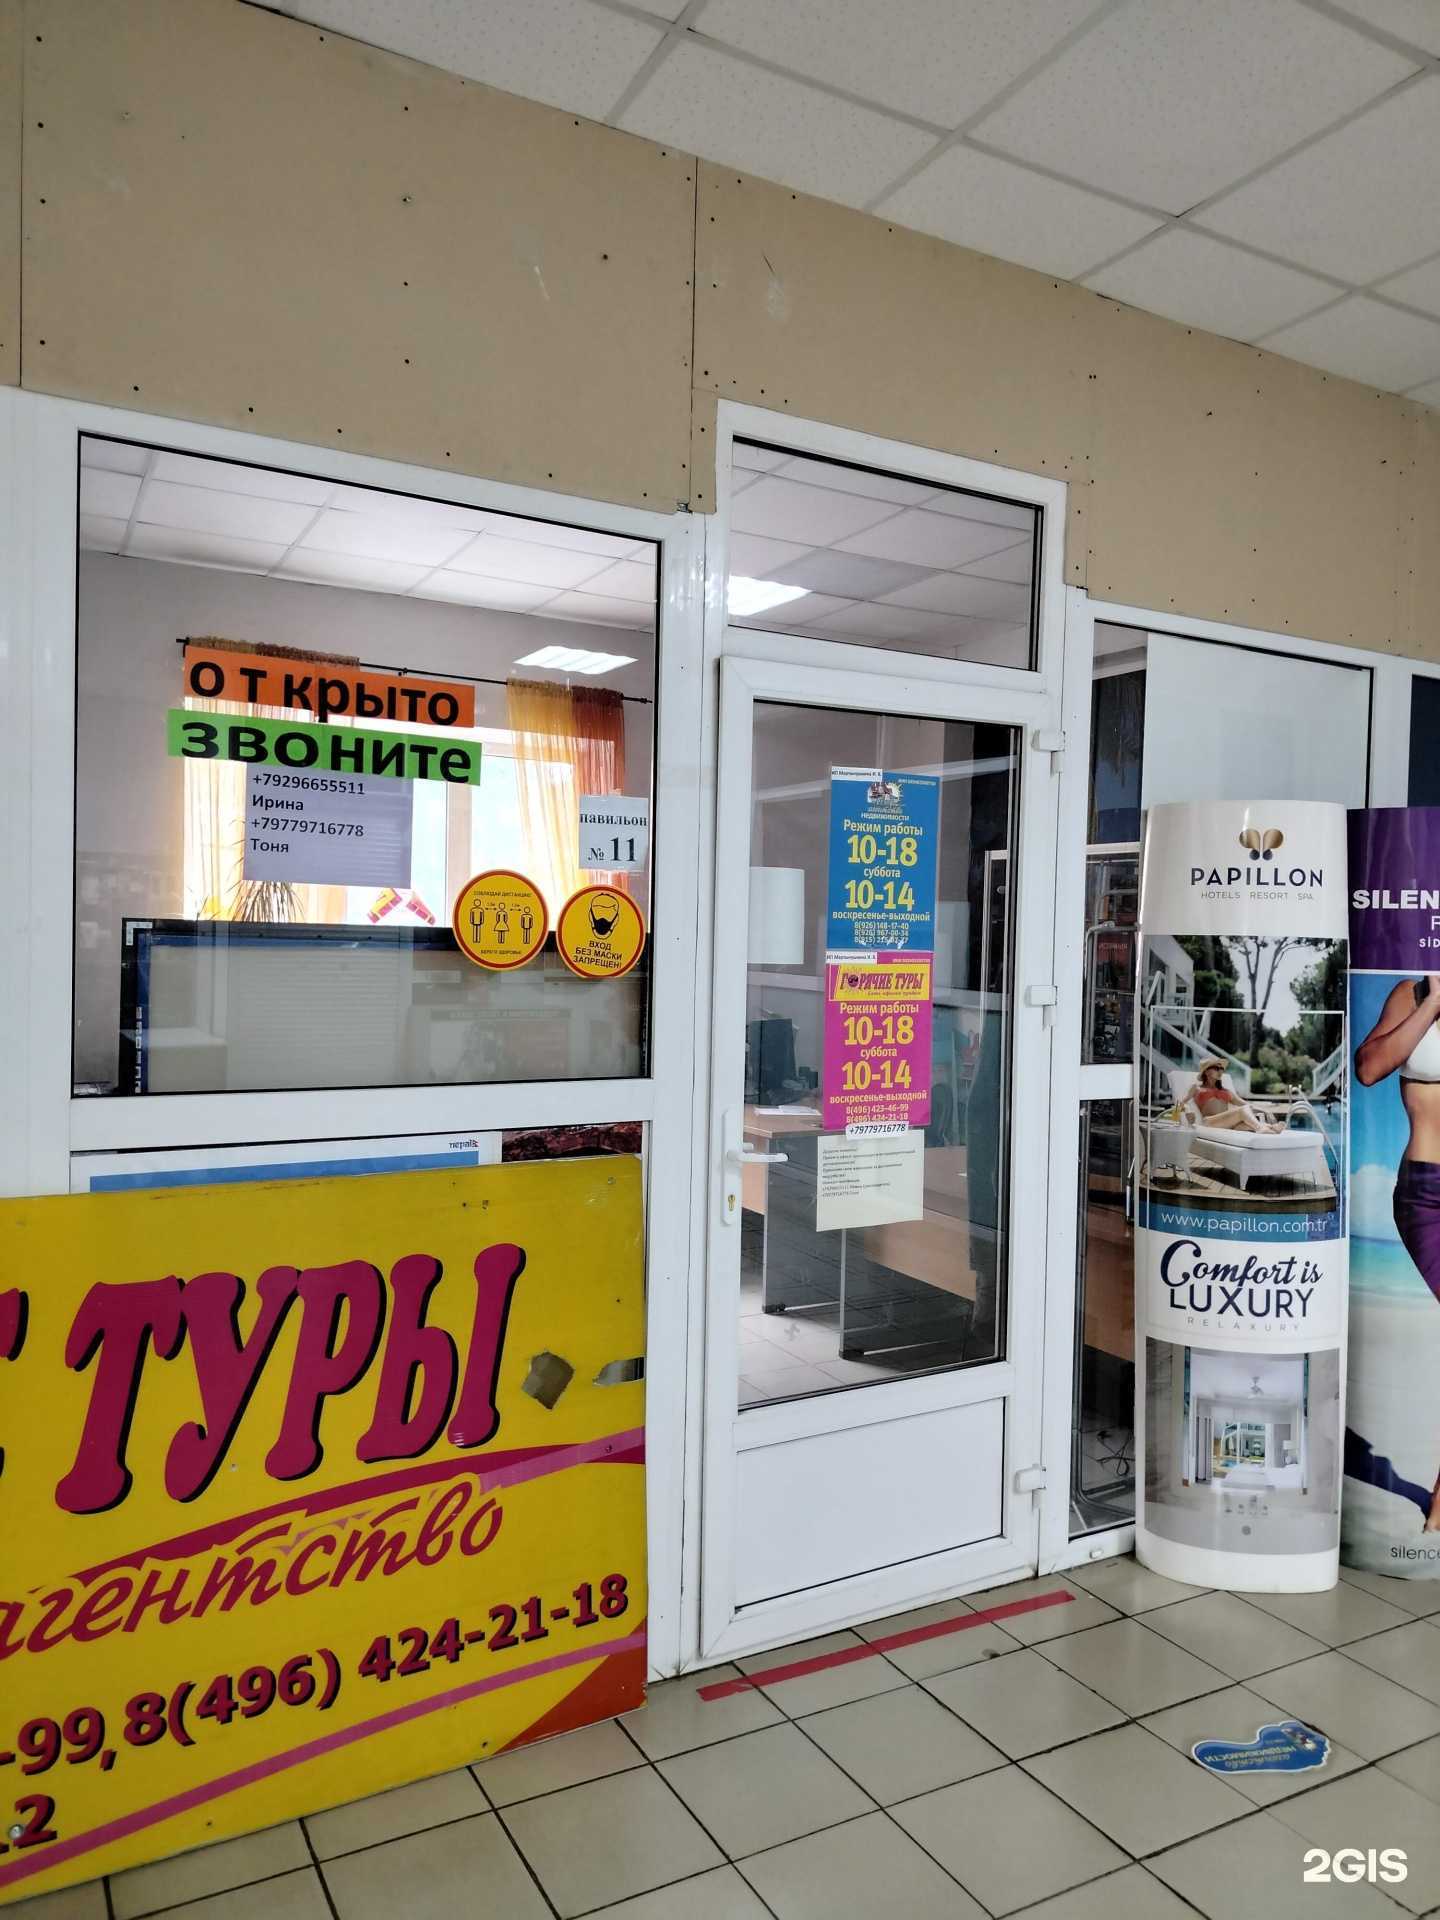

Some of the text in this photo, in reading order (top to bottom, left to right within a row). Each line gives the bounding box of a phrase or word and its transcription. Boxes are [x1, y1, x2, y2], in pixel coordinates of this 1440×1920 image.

[181, 721, 472, 784] звоните
[252, 773, 365, 796] +79296655511
[251, 794, 304, 813] Ирина
[250, 817, 364, 838] +79779716778
[580, 813, 648, 827] павильон
[843, 819, 923, 837] Режим работы
[250, 838, 290, 854] Тоня
[588, 837, 637, 862] № 11
[847, 834, 918, 867] 10-18
[863, 866, 901, 879] суббота
[1190, 867, 1324, 888] PAPILLON
[845, 879, 915, 912] 10-14
[1200, 890, 1315, 901] HOTELS RESORT SPA
[1352, 889, 1440, 910] SILEN
[832, 911, 931, 922] воскресенье-выходной
[575, 947, 622, 960] БЕЗ МАСКИ
[588, 940, 612, 949] ВХОД
[894, 973, 925, 990] ТУРЫ
[840, 1002, 919, 1016] Режим работы
[844, 1016, 914, 1046] 10-18
[860, 1046, 898, 1059] суббота
[842, 1059, 912, 1091] 10-14
[830, 1090, 928, 1105] воскресенье-выходной
[849, 1123, 906, 1135] +79779716778
[1161, 1212, 1328, 1234] www.papillon.com.tr
[1160, 1239, 1324, 1288] Comfort is
[1169, 1283, 1315, 1319] LUXURY
[1187, 1316, 1301, 1332] RELAXURY
[55, 1243, 527, 1514] ТУРЫ
[358, 1573, 629, 1683] 424-21-18
[0, 1793, 57, 1853] 2
